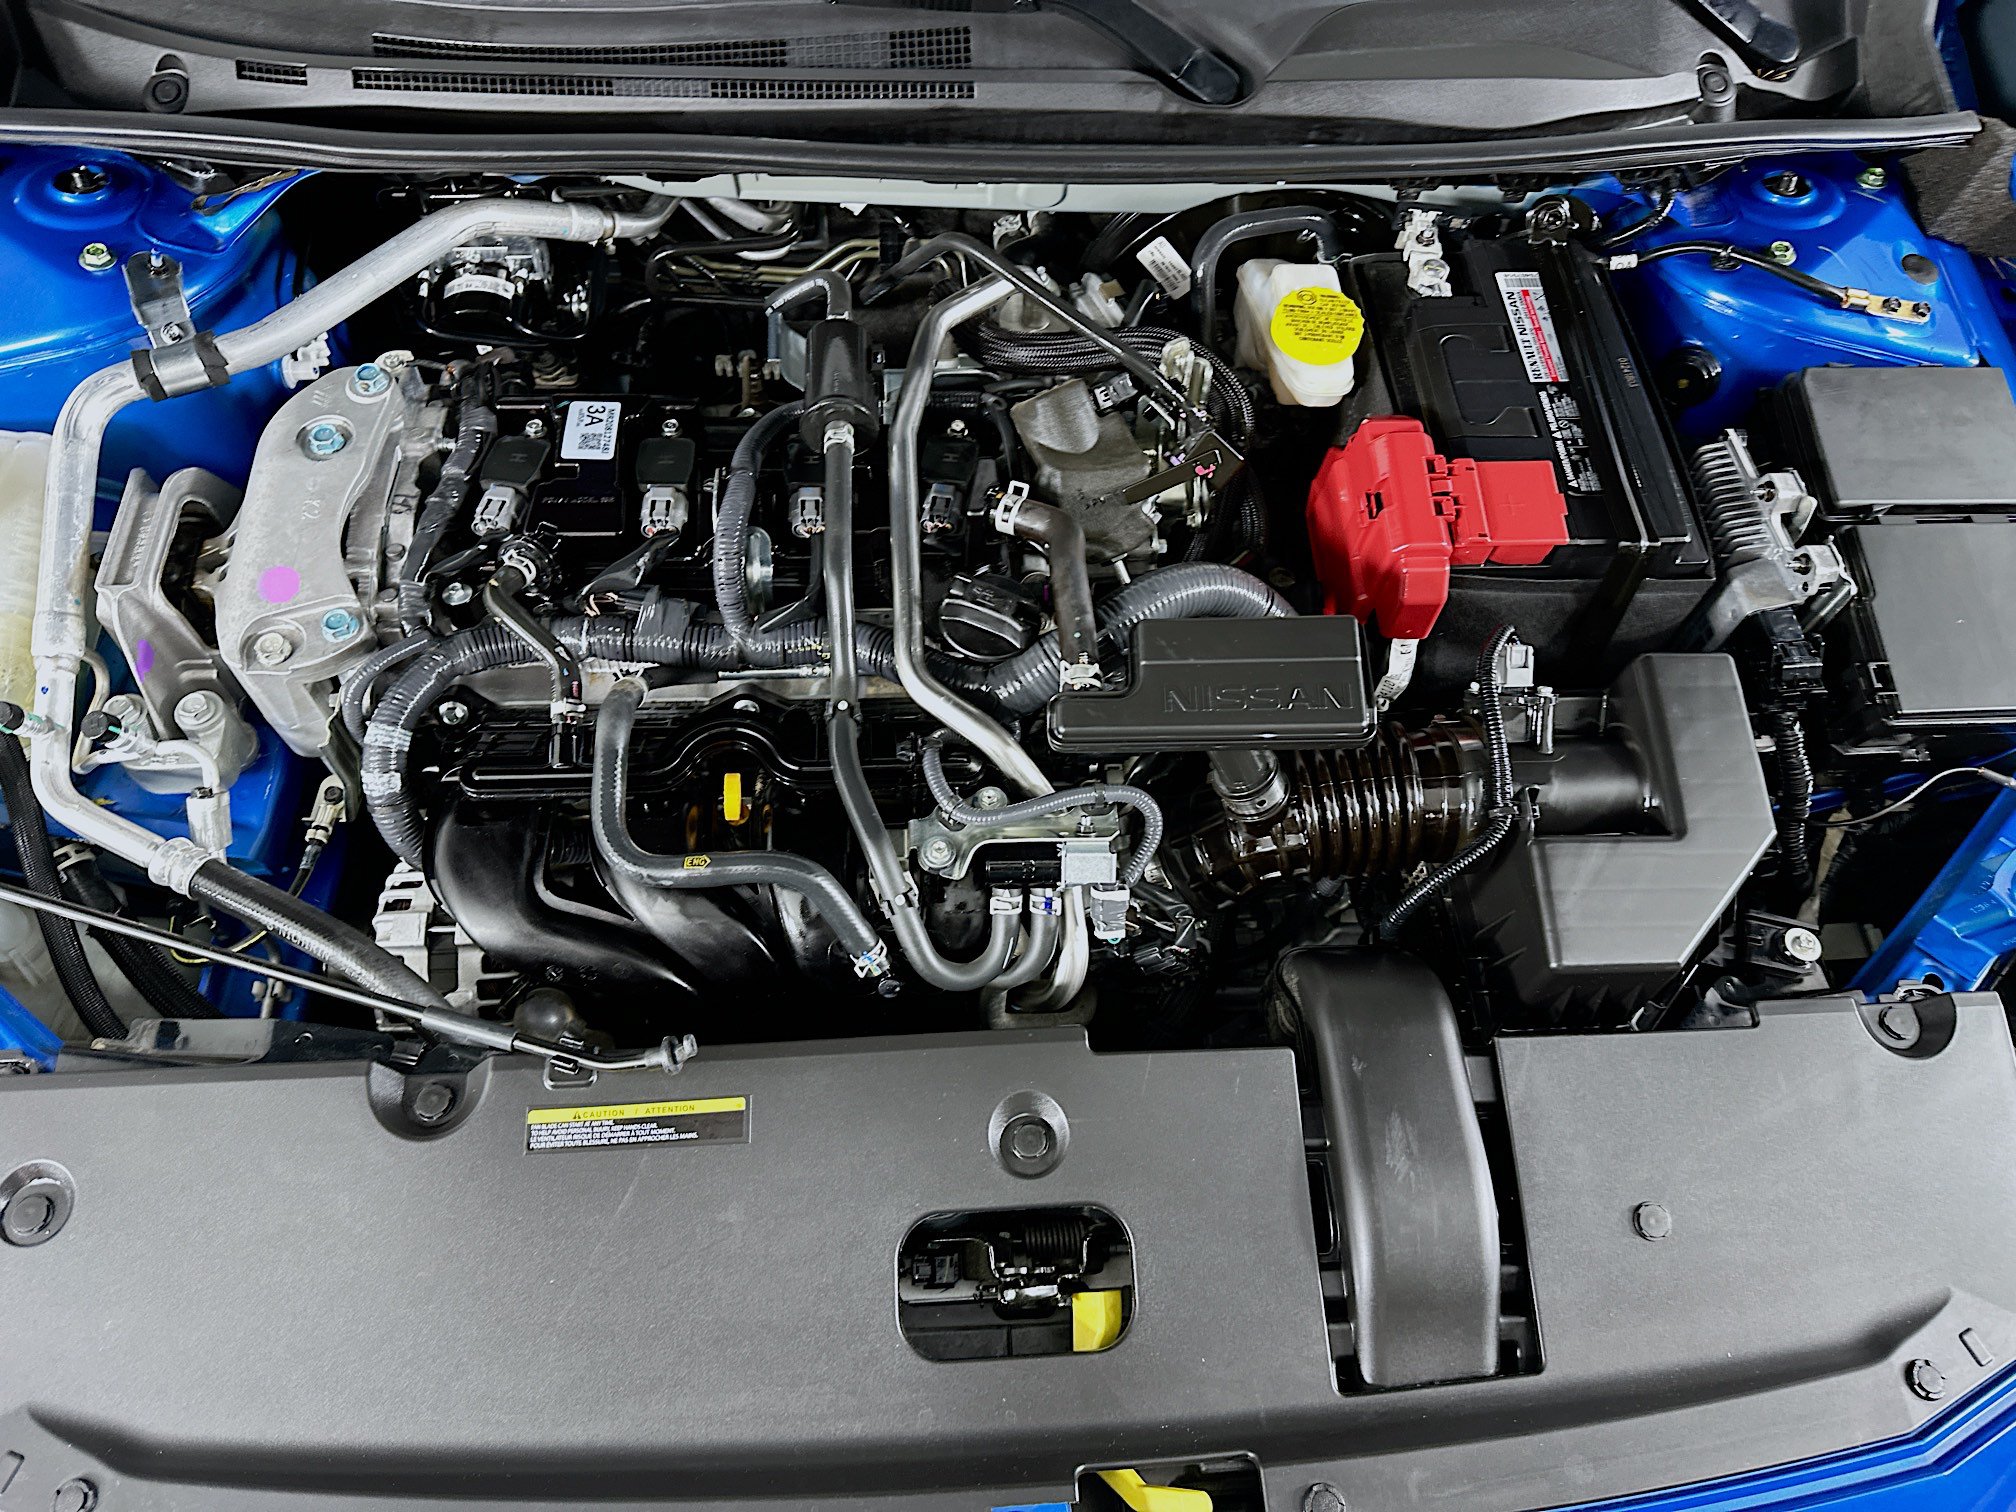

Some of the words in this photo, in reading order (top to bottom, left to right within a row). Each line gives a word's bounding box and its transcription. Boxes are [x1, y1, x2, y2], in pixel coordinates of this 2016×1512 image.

[1506, 291, 1528, 336] NISSAN
[1521, 339, 1543, 380] RENAULT
[584, 405, 606, 427] 3A
[1164, 684, 1355, 713] NISSAN
[687, 857, 706, 867] ENG
[583, 1109, 625, 1119] CAUTION
[645, 1104, 696, 1115] ATTENTION
[537, 1134, 572, 1142] VENTILATEUR
[565, 1139, 583, 1147] TOUTE
[637, 1134, 670, 1142] APPROCHER
